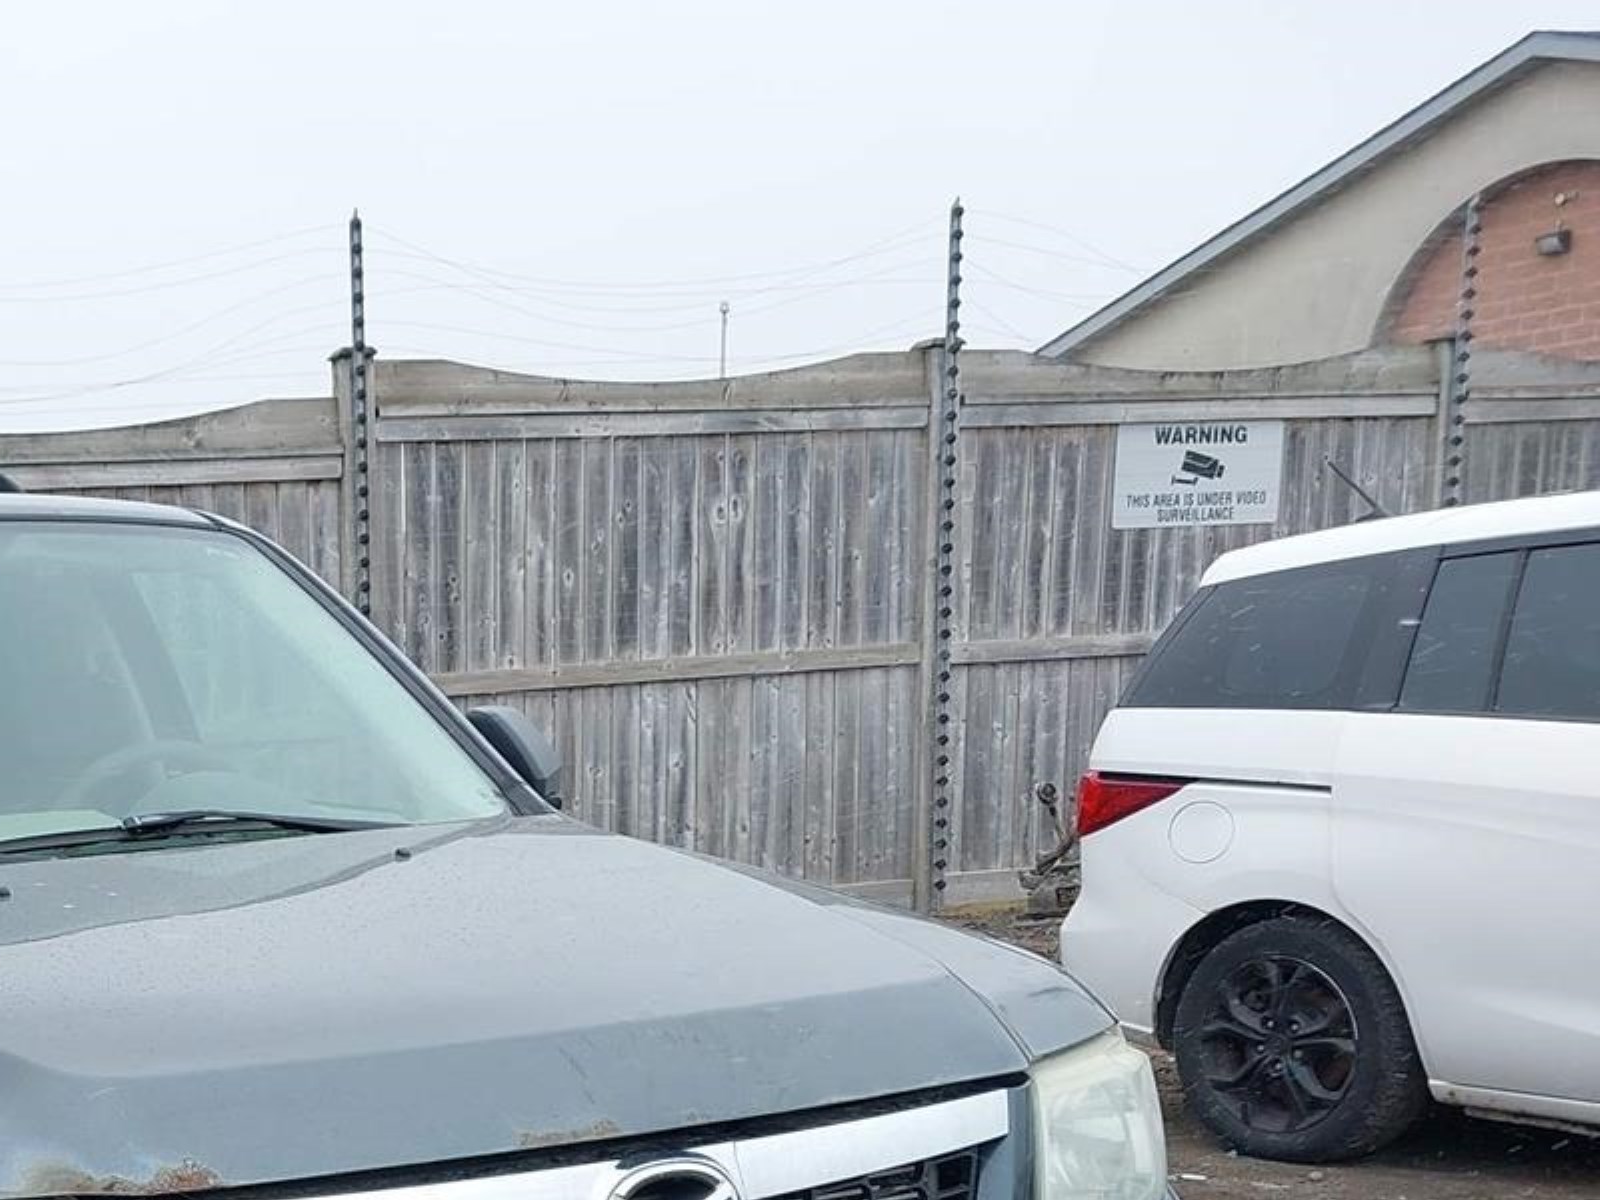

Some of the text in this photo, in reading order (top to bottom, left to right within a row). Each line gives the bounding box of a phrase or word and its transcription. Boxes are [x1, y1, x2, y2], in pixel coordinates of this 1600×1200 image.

[1155, 425, 1248, 445] WARNING
[1127, 490, 1267, 509] THIS AREA IS UNDER VIDEO
[1157, 507, 1234, 523] SURVEILLANCE
